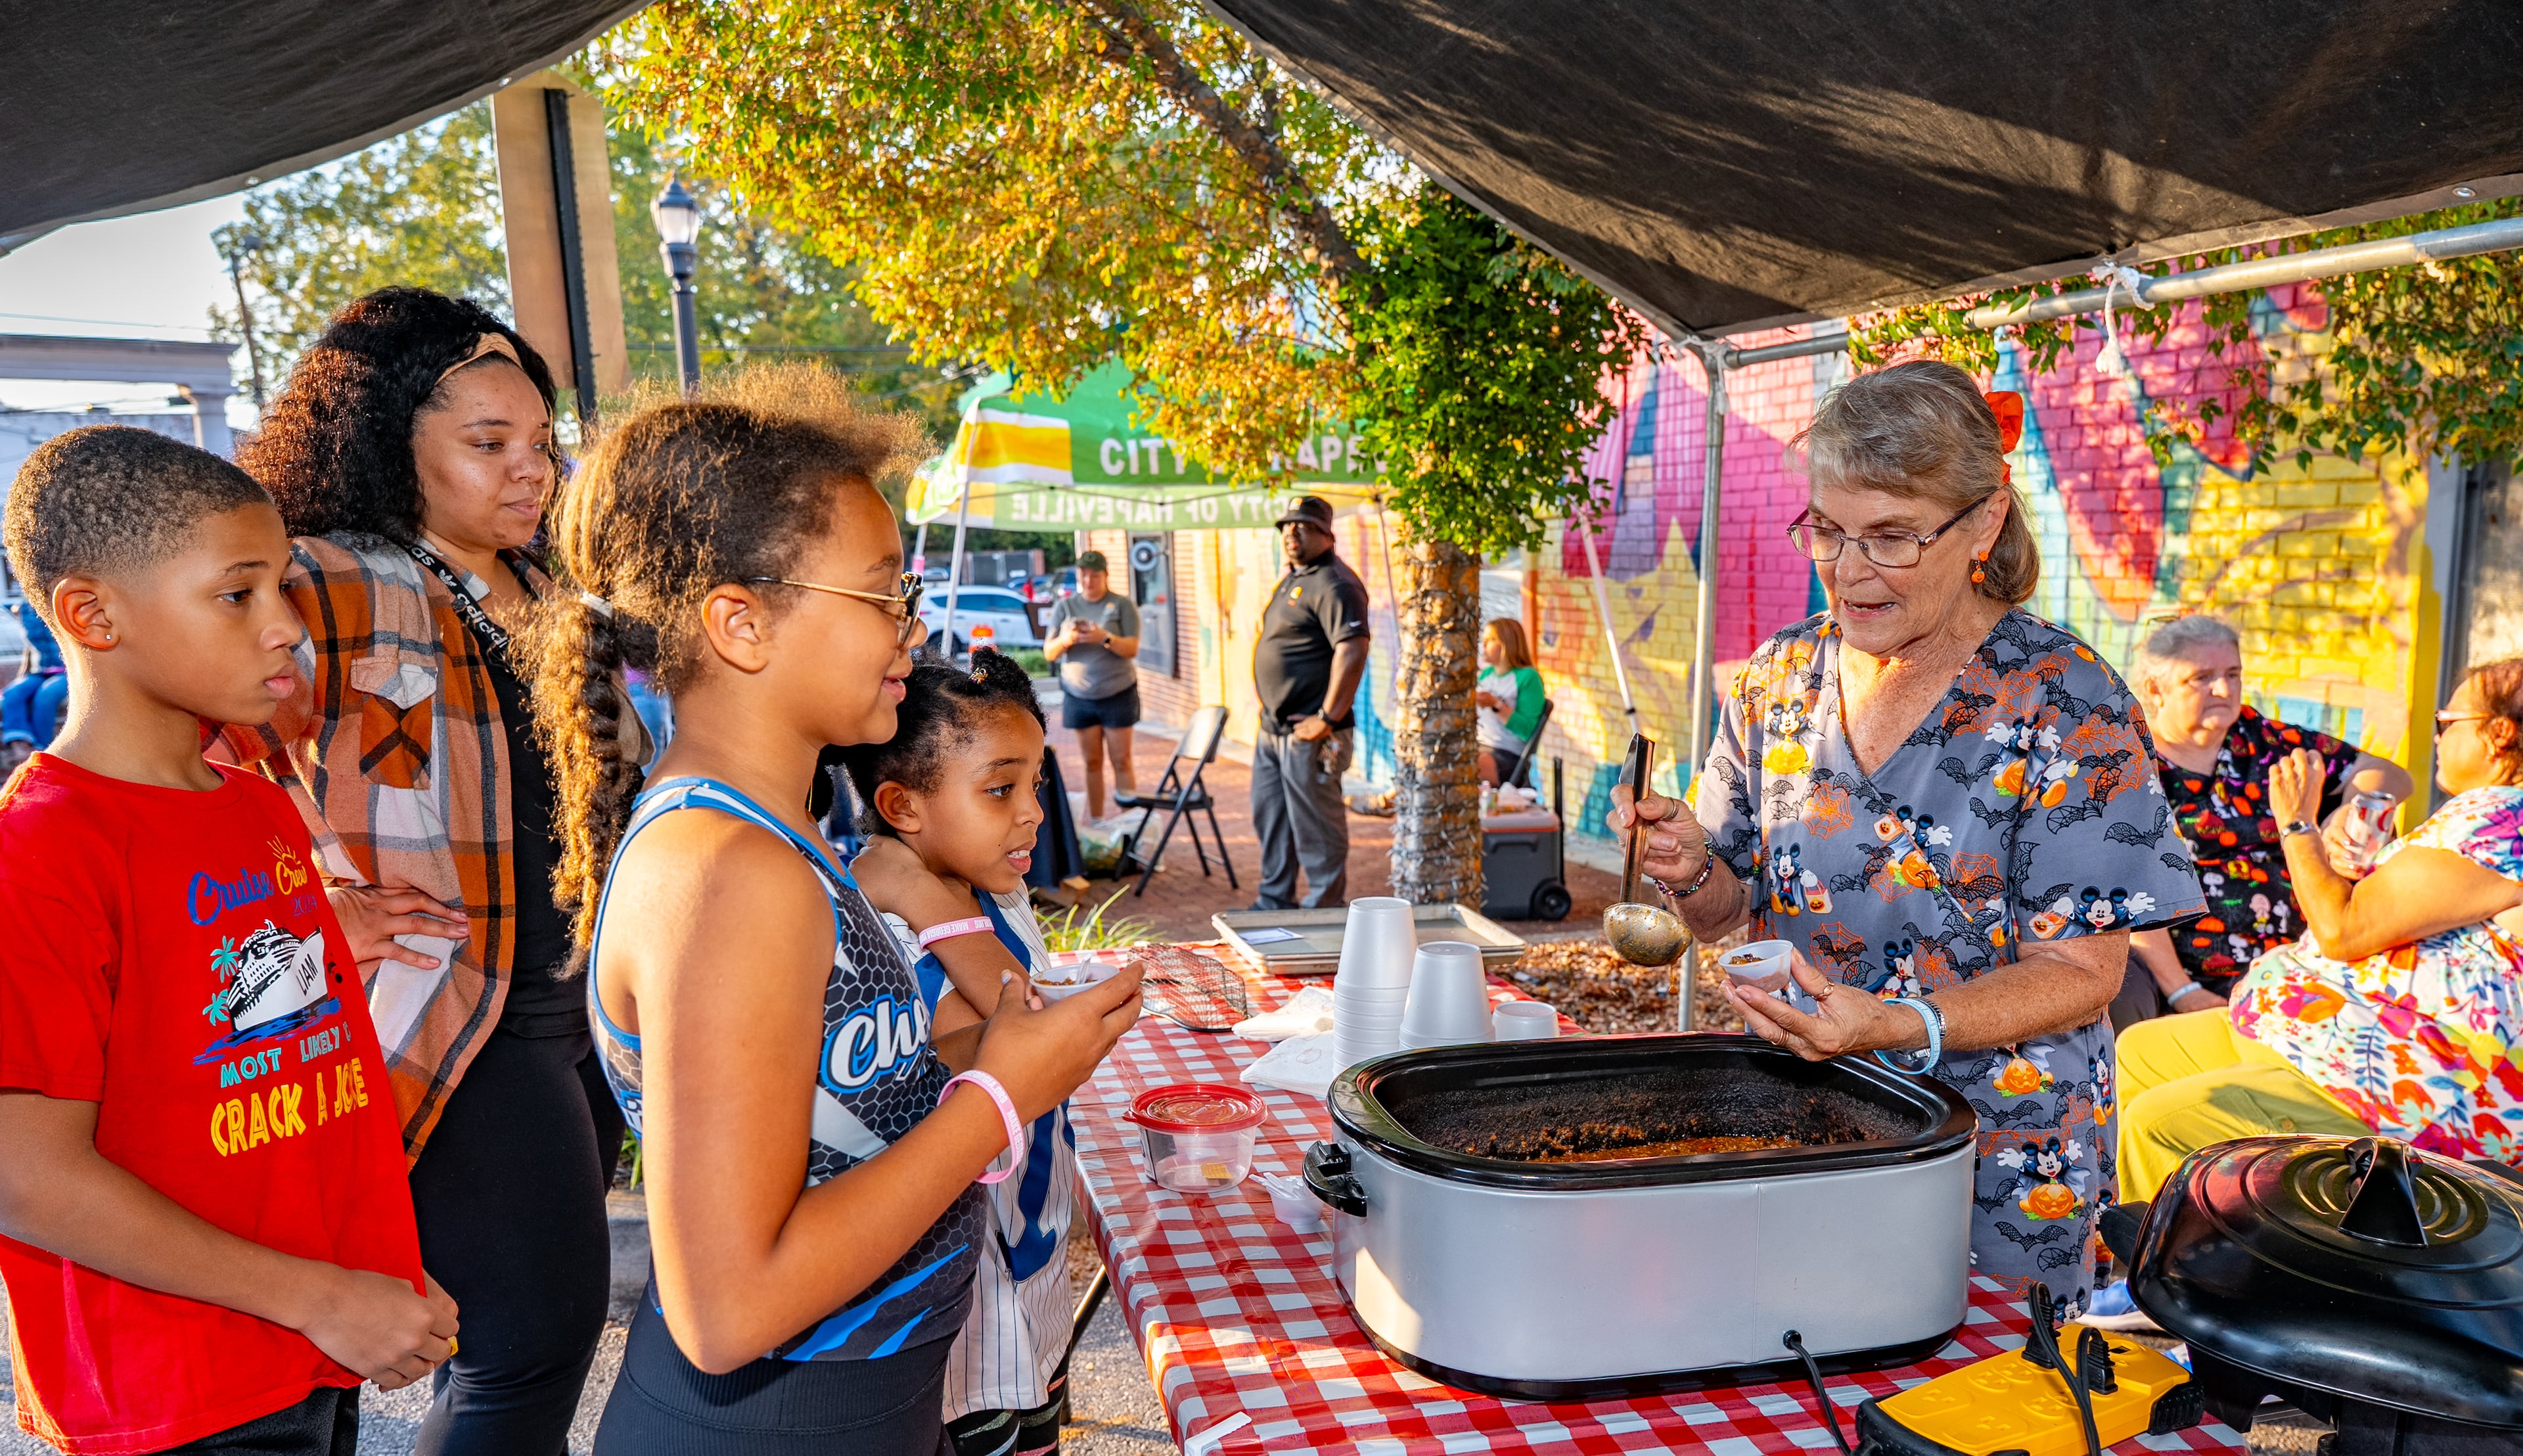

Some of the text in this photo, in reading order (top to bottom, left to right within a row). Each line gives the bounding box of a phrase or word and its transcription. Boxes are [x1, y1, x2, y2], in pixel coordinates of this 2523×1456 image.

[1100, 438, 1186, 476] CITY
[187, 860, 307, 926] Cruise Crew
[291, 894, 317, 917] 2024
[926, 924, 951, 940] GEORGIA
[951, 921, 969, 933] MAKE
[296, 953, 318, 996] LIAM
[221, 1047, 282, 1088] MOST
[300, 1026, 340, 1062] LIKELY
[210, 1082, 307, 1157] CRACK
[317, 1072, 328, 1126] A
[1007, 1108, 1021, 1135] MAKE
